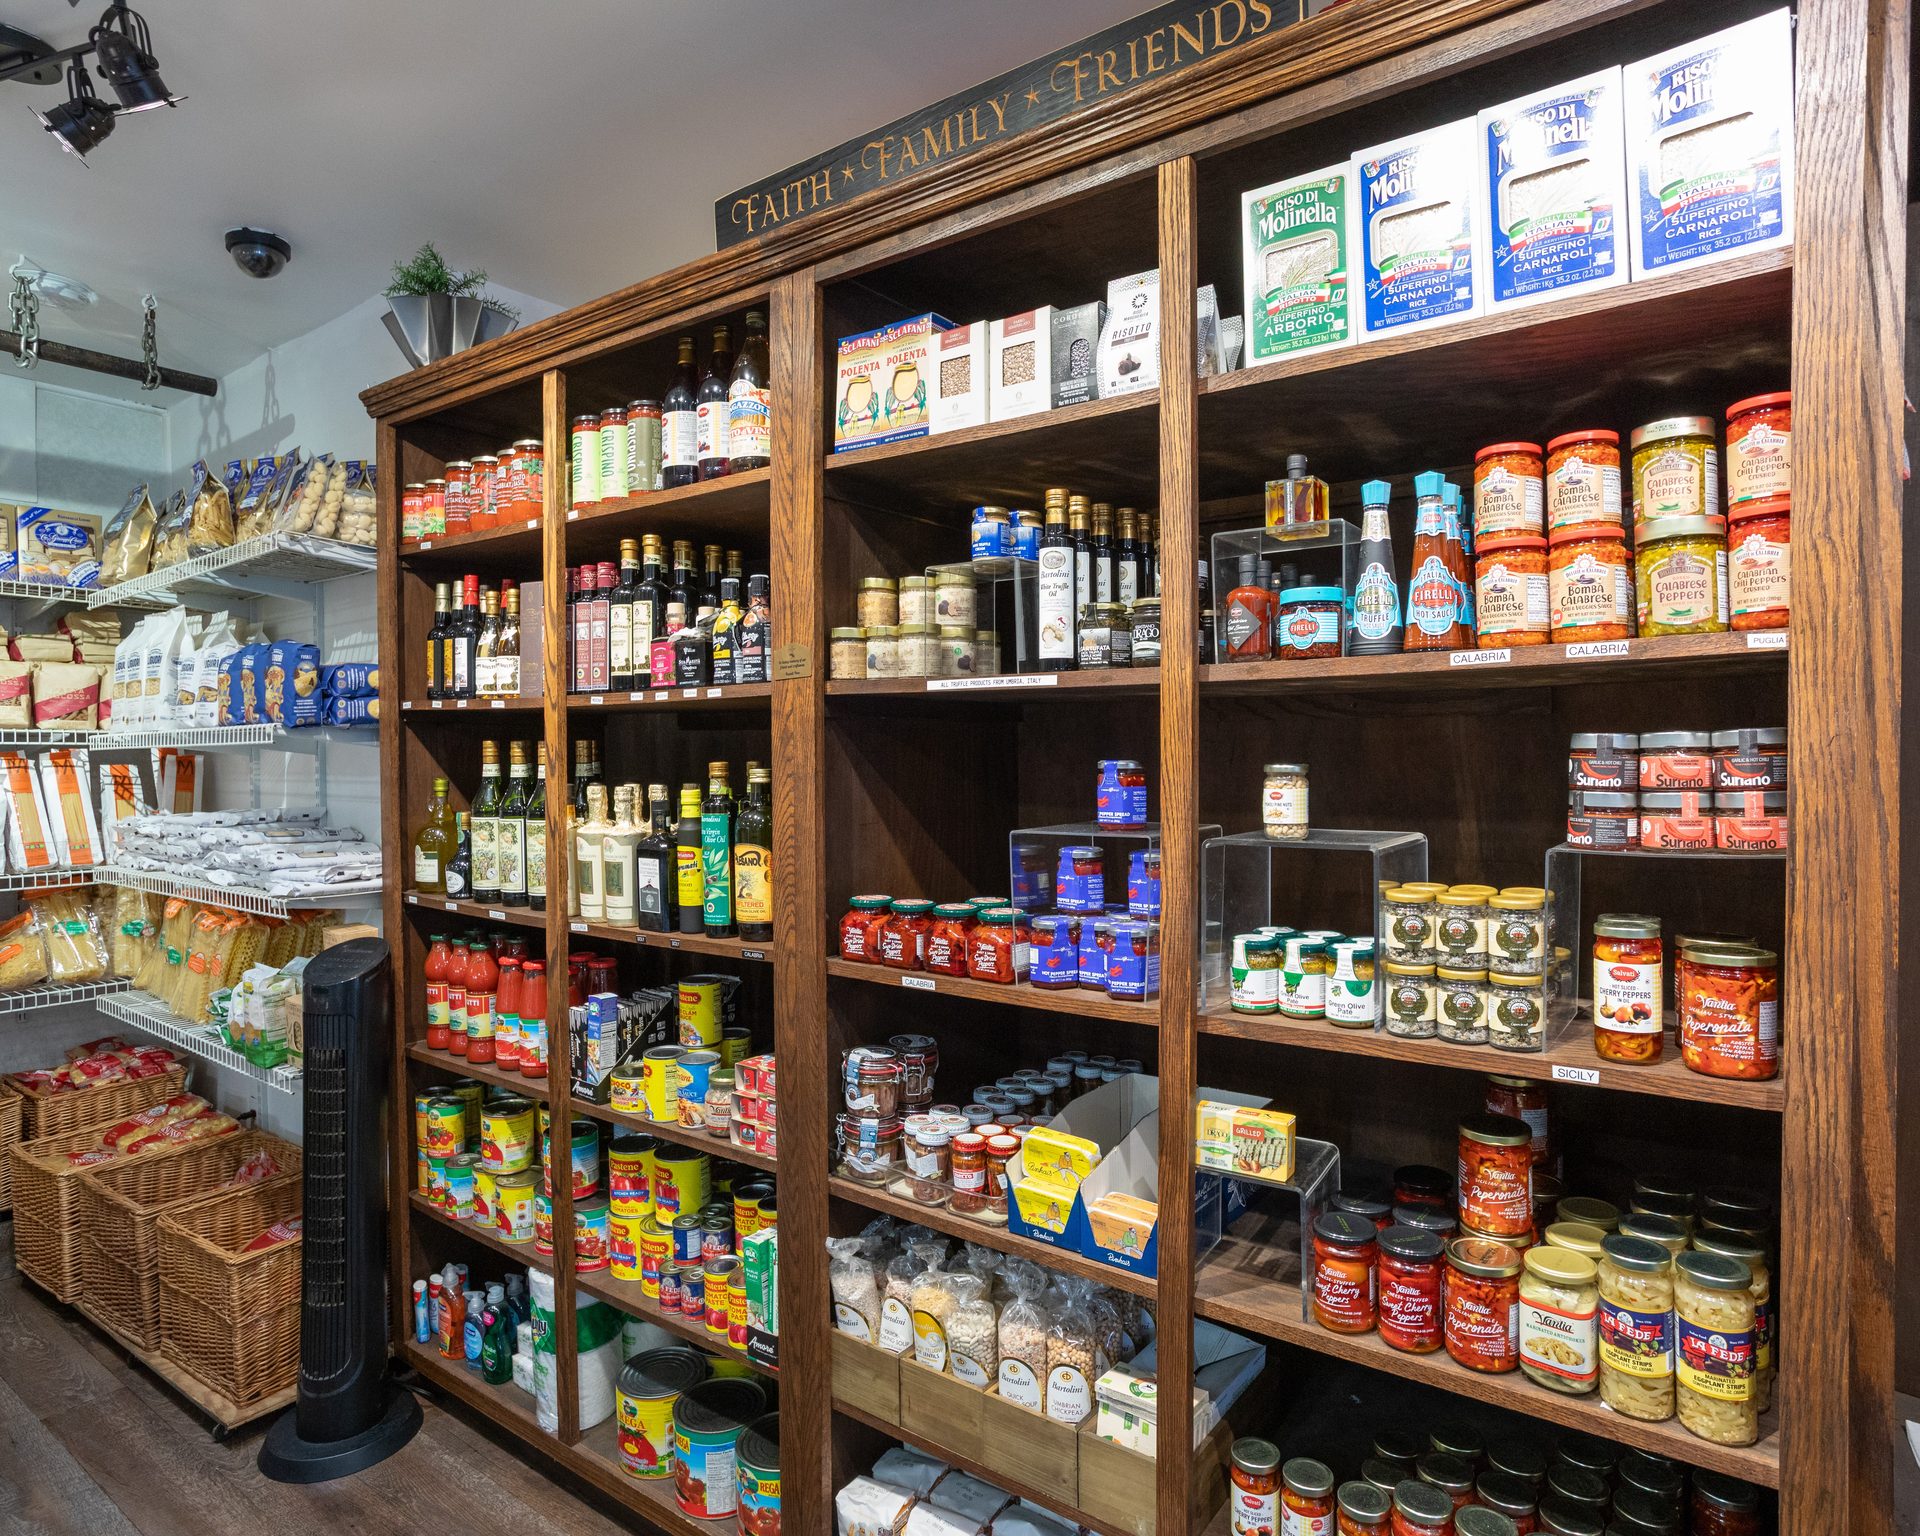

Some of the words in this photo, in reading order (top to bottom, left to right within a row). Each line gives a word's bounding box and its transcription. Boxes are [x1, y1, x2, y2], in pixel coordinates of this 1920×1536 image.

[731, 168, 832, 234] FAITH
[861, 92, 1012, 180] FAMILY
[1049, 0, 1275, 103] FRIENDS
[1559, 104, 1577, 120] DI
[1678, 178, 1735, 200] ITALIAN
[1680, 186, 1736, 207] RISOTTO
[1275, 193, 1303, 211] RISO
[1307, 190, 1318, 203] DI
[1564, 211, 1578, 220] FOR
[1671, 198, 1749, 226] SUPERFINO
[1258, 202, 1337, 248] Molinella
[1525, 219, 1574, 237] ITALIAN
[1665, 207, 1757, 239] CARNAROLI
[1526, 226, 1574, 244] RISOTTO
[1698, 227, 1722, 240] RICE
[1518, 239, 1586, 262] SUPERFINO
[1653, 254, 1667, 265] NET
[1667, 246, 1698, 264] WEIGHT:
[1714, 238, 1731, 249] 35.2
[1393, 257, 1437, 273] ITALIAN
[1513, 247, 1592, 273] CARNAROLI
[1394, 263, 1437, 279] RISOTTO
[1542, 265, 1562, 275] RICE
[1388, 275, 1447, 294] SUPERFINO
[1503, 288, 1514, 297] NET
[1556, 275, 1570, 285] 35.2
[1278, 289, 1317, 304] ITALIAN
[1383, 283, 1453, 305] CARNAROLI
[1279, 296, 1317, 310] RISOTTO
[1409, 299, 1427, 308] RICE
[1273, 306, 1325, 324] SUPERFINO
[1112, 323, 1152, 339] RISOTTO
[1264, 312, 1335, 337] ARBORIO
[1374, 319, 1385, 328] NET
[888, 322, 926, 342] SCLAFANI
[1291, 329, 1307, 337] RICE
[842, 338, 880, 355] SCLAFANI
[886, 348, 927, 366] POLENTA
[840, 362, 880, 378] POLENTA
[573, 435, 583, 483] CRISPINO
[601, 429, 614, 478] CRISPINO
[1364, 577, 1388, 586] ITALIAN
[1420, 572, 1446, 582] ITALIAN
[1357, 595, 1393, 606] FIRELLI
[1415, 590, 1452, 601] FIRELLI
[1361, 612, 1389, 623] TRUFFLE
[1416, 610, 1429, 619] HOT
[1432, 610, 1453, 618] SAUCE
[1290, 624, 1315, 632] FIRELLI
[1753, 636, 1784, 644] PUGLIA
[1569, 643, 1628, 656] CALABRIA
[1453, 651, 1507, 664] CALABRIA
[1577, 773, 1622, 787] Suriano
[1656, 774, 1703, 788] Suriano
[1721, 772, 1770, 786] Suriano
[1661, 834, 1707, 848] Suriano
[1727, 835, 1777, 850] Suriano
[904, 978, 934, 988] CALABRIA
[1600, 986, 1621, 998] CHERRY
[1623, 990, 1651, 1000] PEPPERS
[1347, 1002, 1365, 1010] Olive
[1686, 1015, 1753, 1034] Peperonata
[1558, 1067, 1595, 1082] SICILY
[1235, 1127, 1261, 1137] GRILLED
[611, 1159, 639, 1171] Pastene
[1471, 1185, 1527, 1202] Peperonata
[1321, 1291, 1349, 1306] Peppers
[1332, 1286, 1360, 1299] Cherry
[1382, 1296, 1402, 1310] Sweet
[1404, 1302, 1432, 1314] Cherry
[1391, 1310, 1423, 1323] Peppers
[1448, 1312, 1504, 1335] Peperonata
[1526, 1323, 1553, 1336] MARINATED
[1603, 1313, 1615, 1327] LA
[1618, 1321, 1651, 1340] FEDE
[1614, 1348, 1641, 1360] MARINATED
[1690, 1337, 1706, 1351] LA
[1710, 1345, 1744, 1361] FEDE
[1606, 1349, 1630, 1364] EGGPLANT
[1632, 1359, 1652, 1368] STRIPS
[1001, 1373, 1031, 1386] Bartolini
[1693, 1375, 1724, 1388] EGGPLANT
[1705, 1374, 1735, 1384] MARINATED
[1052, 1382, 1083, 1393] Bartolini
[1007, 1391, 1023, 1400] QUICK
[1052, 1406, 1084, 1415] CHICKPEAS
[1053, 1400, 1081, 1409] UMBRIAN
[618, 1412, 645, 1429] REGA
[676, 1434, 690, 1452] REGA
[760, 1480, 780, 1495] REGA
